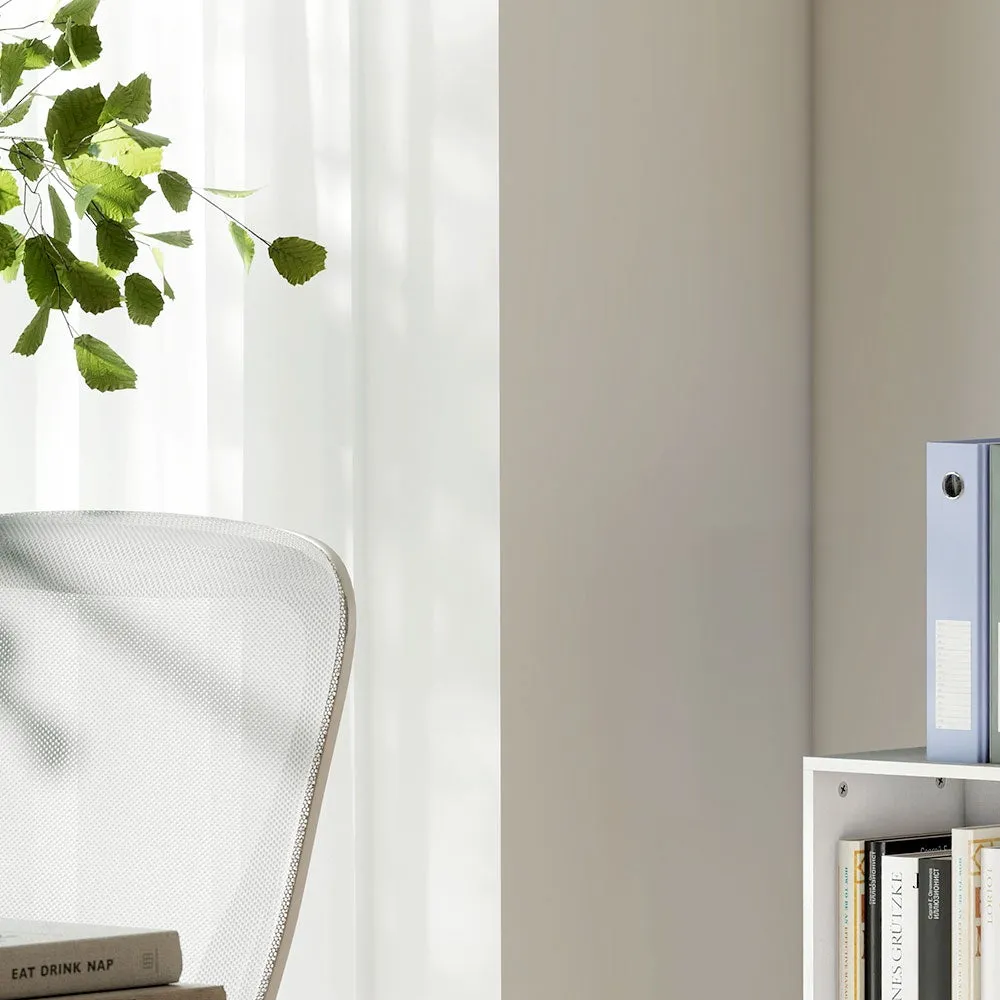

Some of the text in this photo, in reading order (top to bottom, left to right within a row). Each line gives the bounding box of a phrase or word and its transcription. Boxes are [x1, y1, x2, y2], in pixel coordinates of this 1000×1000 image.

[890, 872, 902, 962] GRÜTZKE
[12, 959, 114, 980] EAT DRINK NAP
